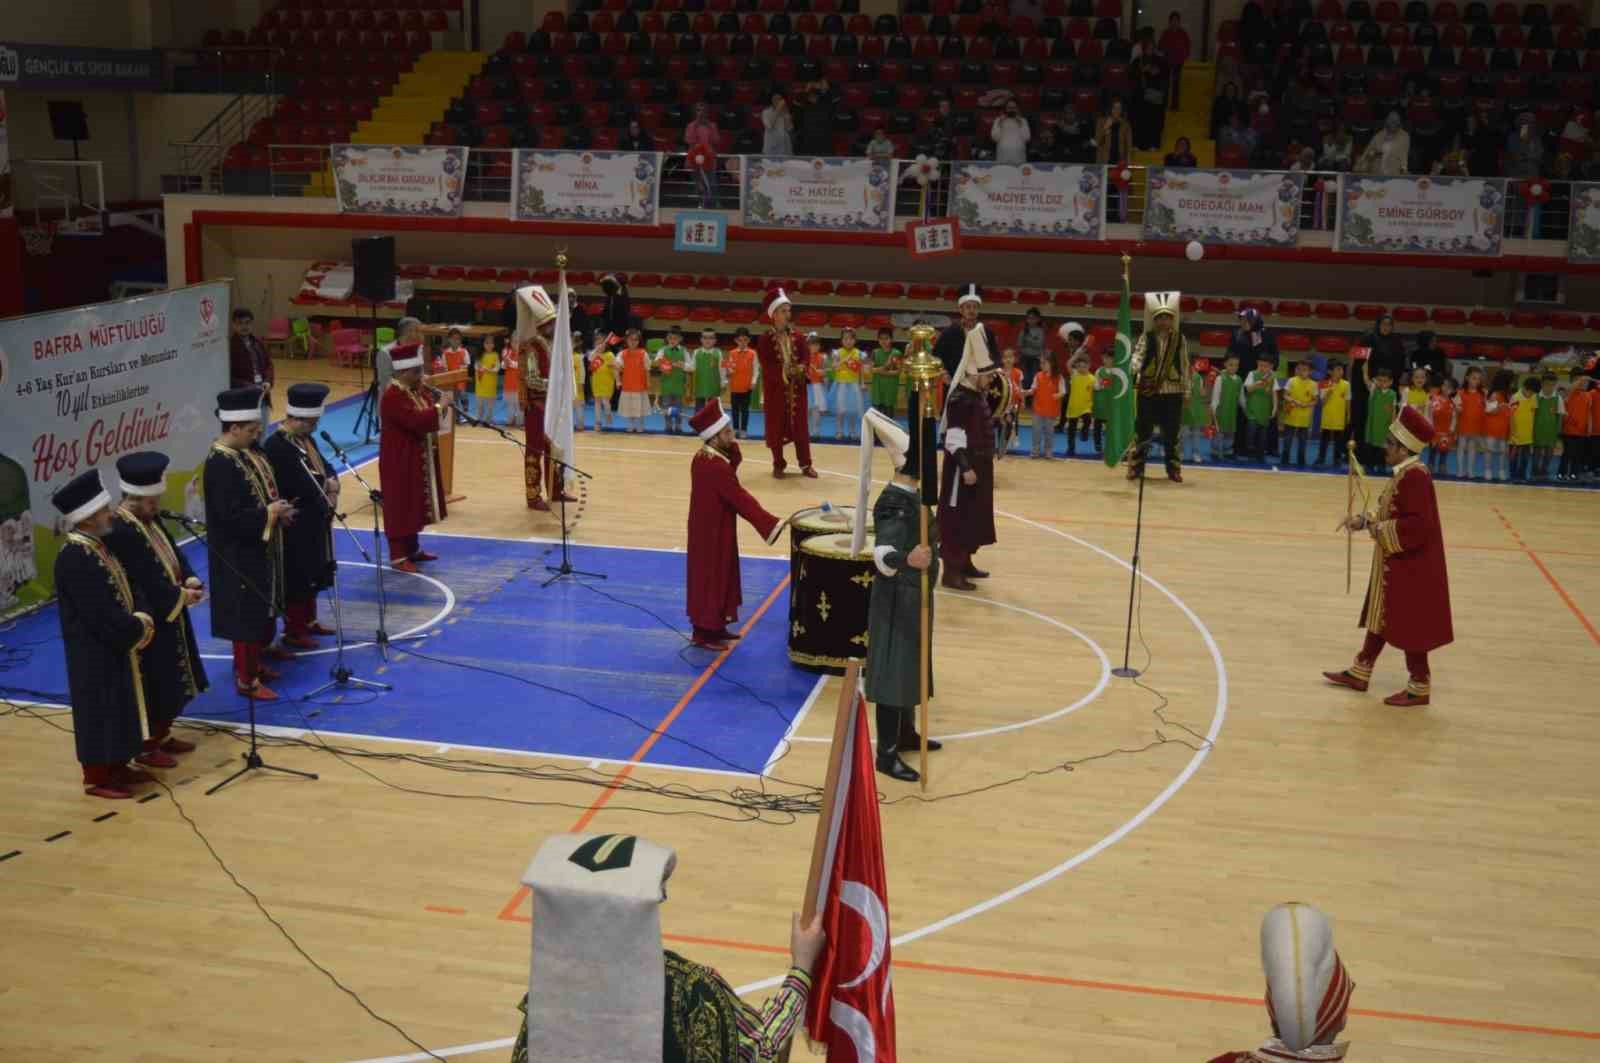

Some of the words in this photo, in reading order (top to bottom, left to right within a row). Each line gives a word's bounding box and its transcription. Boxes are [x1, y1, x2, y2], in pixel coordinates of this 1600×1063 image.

[33, 333, 83, 360] BAFRA
[89, 311, 167, 348] MÜFTÜLÜĞÜ
[16, 382, 33, 396] 4-6
[35, 377, 53, 394] Yaş
[55, 369, 88, 388] Kur'an
[90, 361, 128, 380] Kursları
[129, 358, 139, 369] ve
[56, 390, 71, 416] 10
[92, 384, 150, 410] Etkinliklerine
[33, 432, 82, 482] Hoş
[86, 402, 171, 465] Geldiniz
